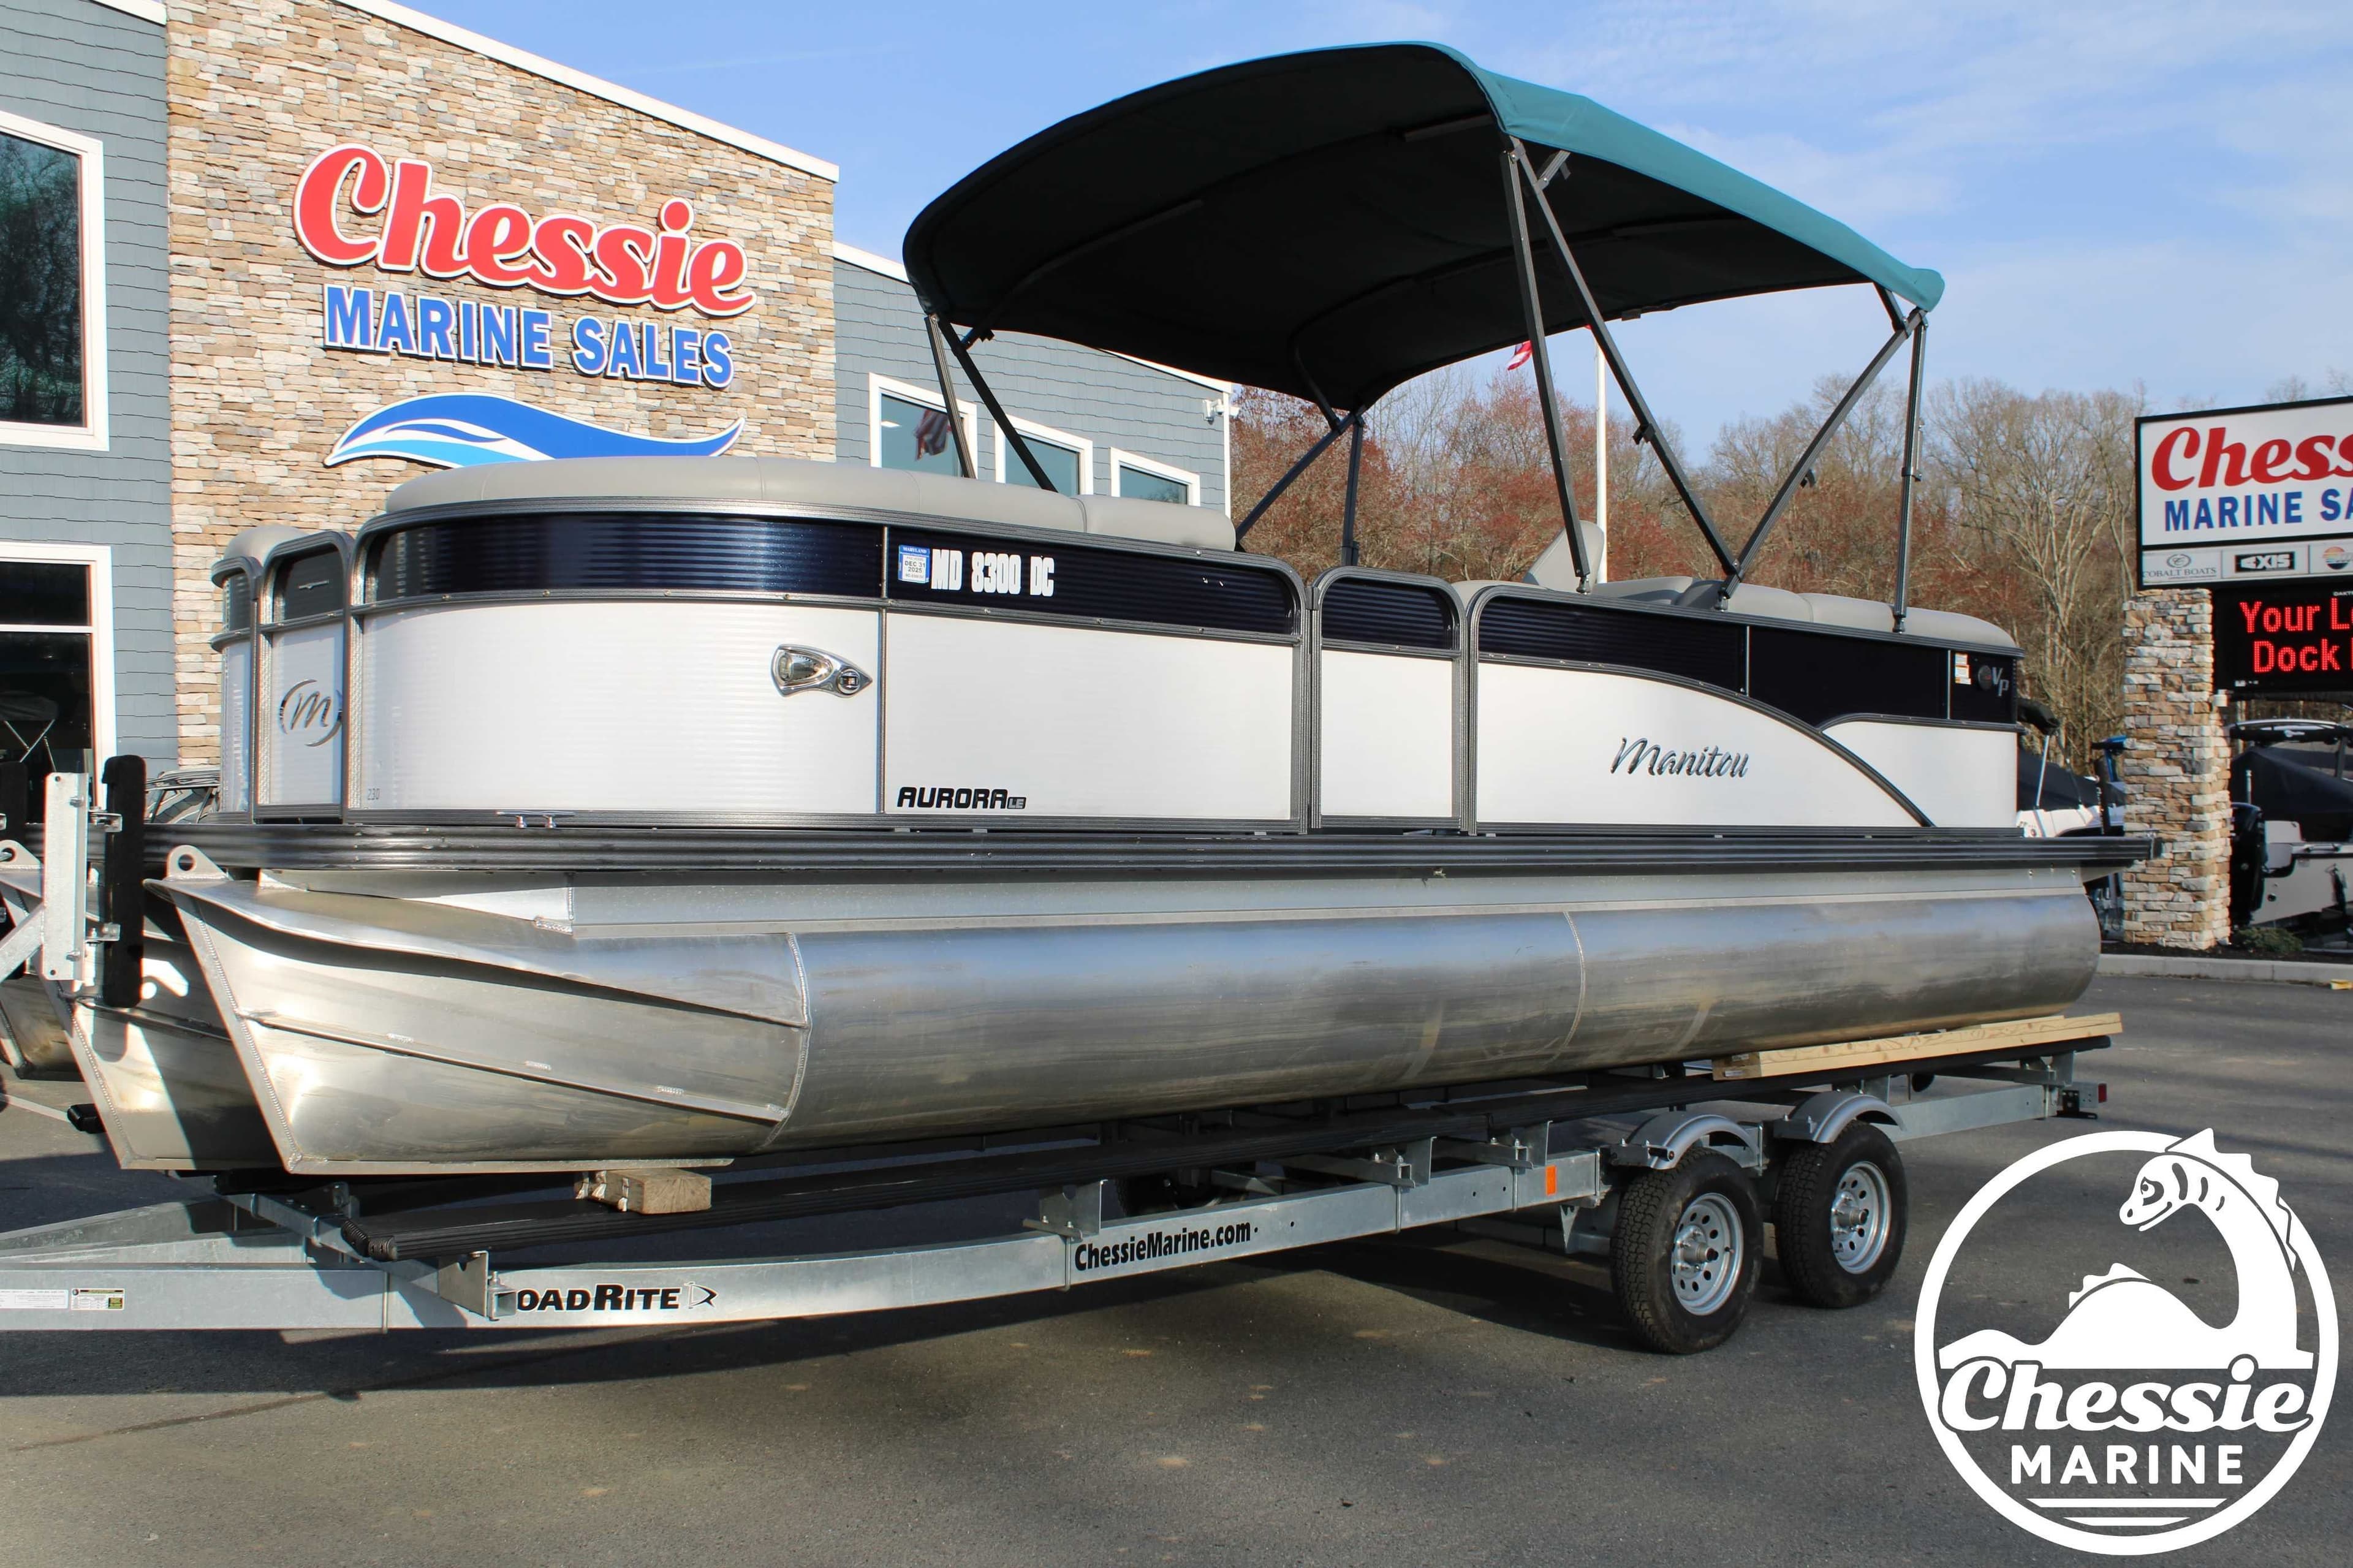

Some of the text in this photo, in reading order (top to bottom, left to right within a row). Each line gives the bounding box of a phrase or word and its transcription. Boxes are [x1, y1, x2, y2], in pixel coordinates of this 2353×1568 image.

[294, 143, 757, 317] Chessie
[324, 284, 735, 388] MARINE SALES
[2165, 491, 2302, 531] MARINE
[931, 548, 1055, 597] MD 8300 DC
[2184, 567, 2217, 576] BOATS
[2240, 553, 2290, 569] AXIS
[2240, 597, 2353, 633] Your L
[2254, 638, 2340, 673] Dock
[1610, 737, 1749, 778] Manitou
[897, 786, 1008, 809] AURORA
[1075, 1221, 1251, 1271] ChessieMarine.com
[517, 1283, 681, 1311] OADRITE
